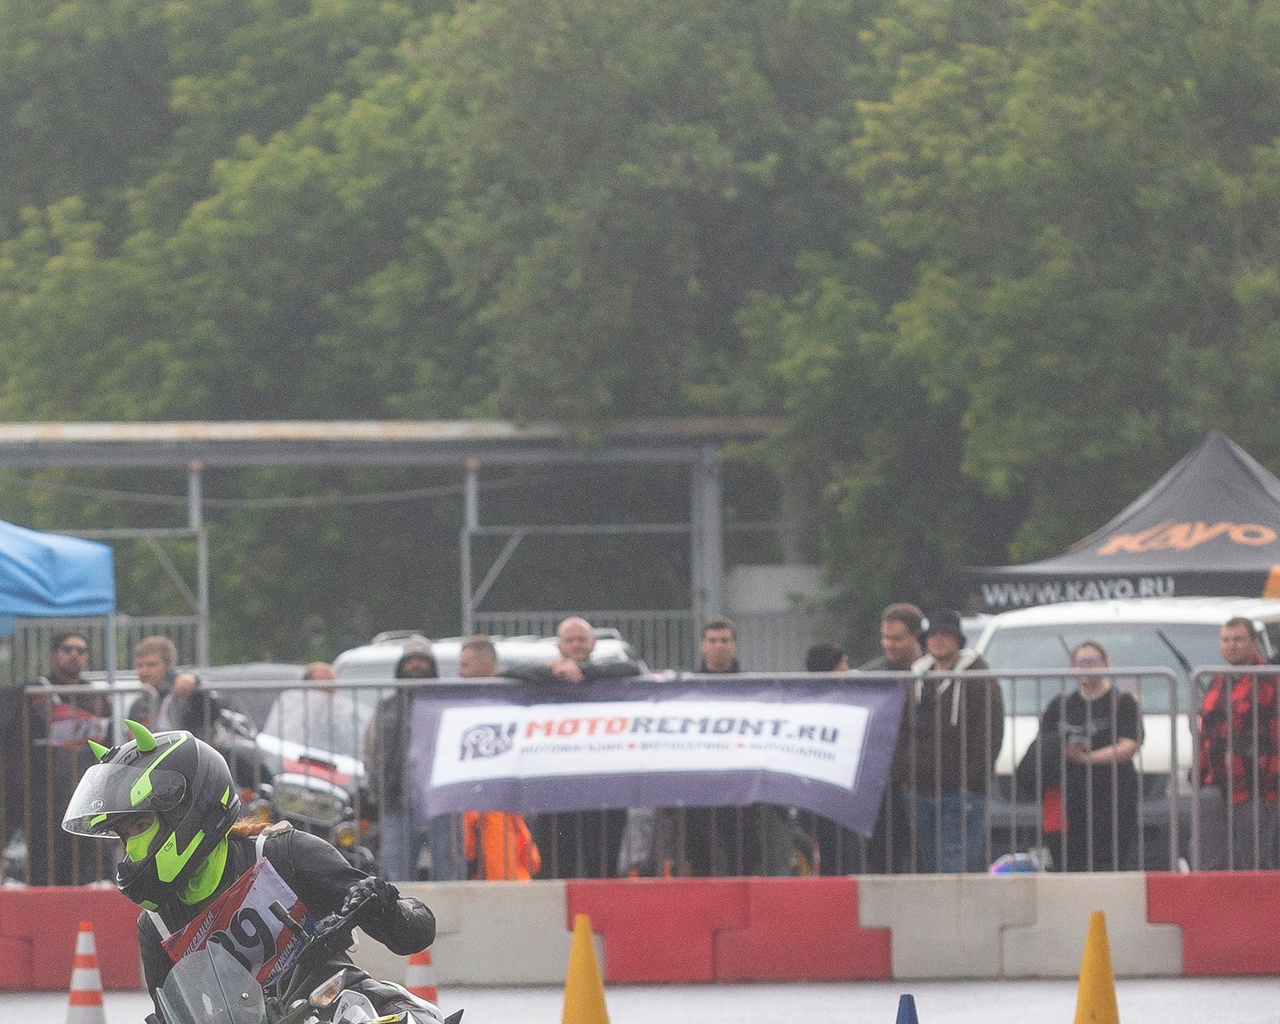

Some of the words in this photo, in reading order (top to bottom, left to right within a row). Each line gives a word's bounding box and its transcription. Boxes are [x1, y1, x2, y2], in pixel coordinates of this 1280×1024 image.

[1097, 521, 1277, 556] KAYO
[981, 576, 1175, 606] WWW.KAYO.RU
[524, 716, 838, 743] MOTOREMONT.RU
